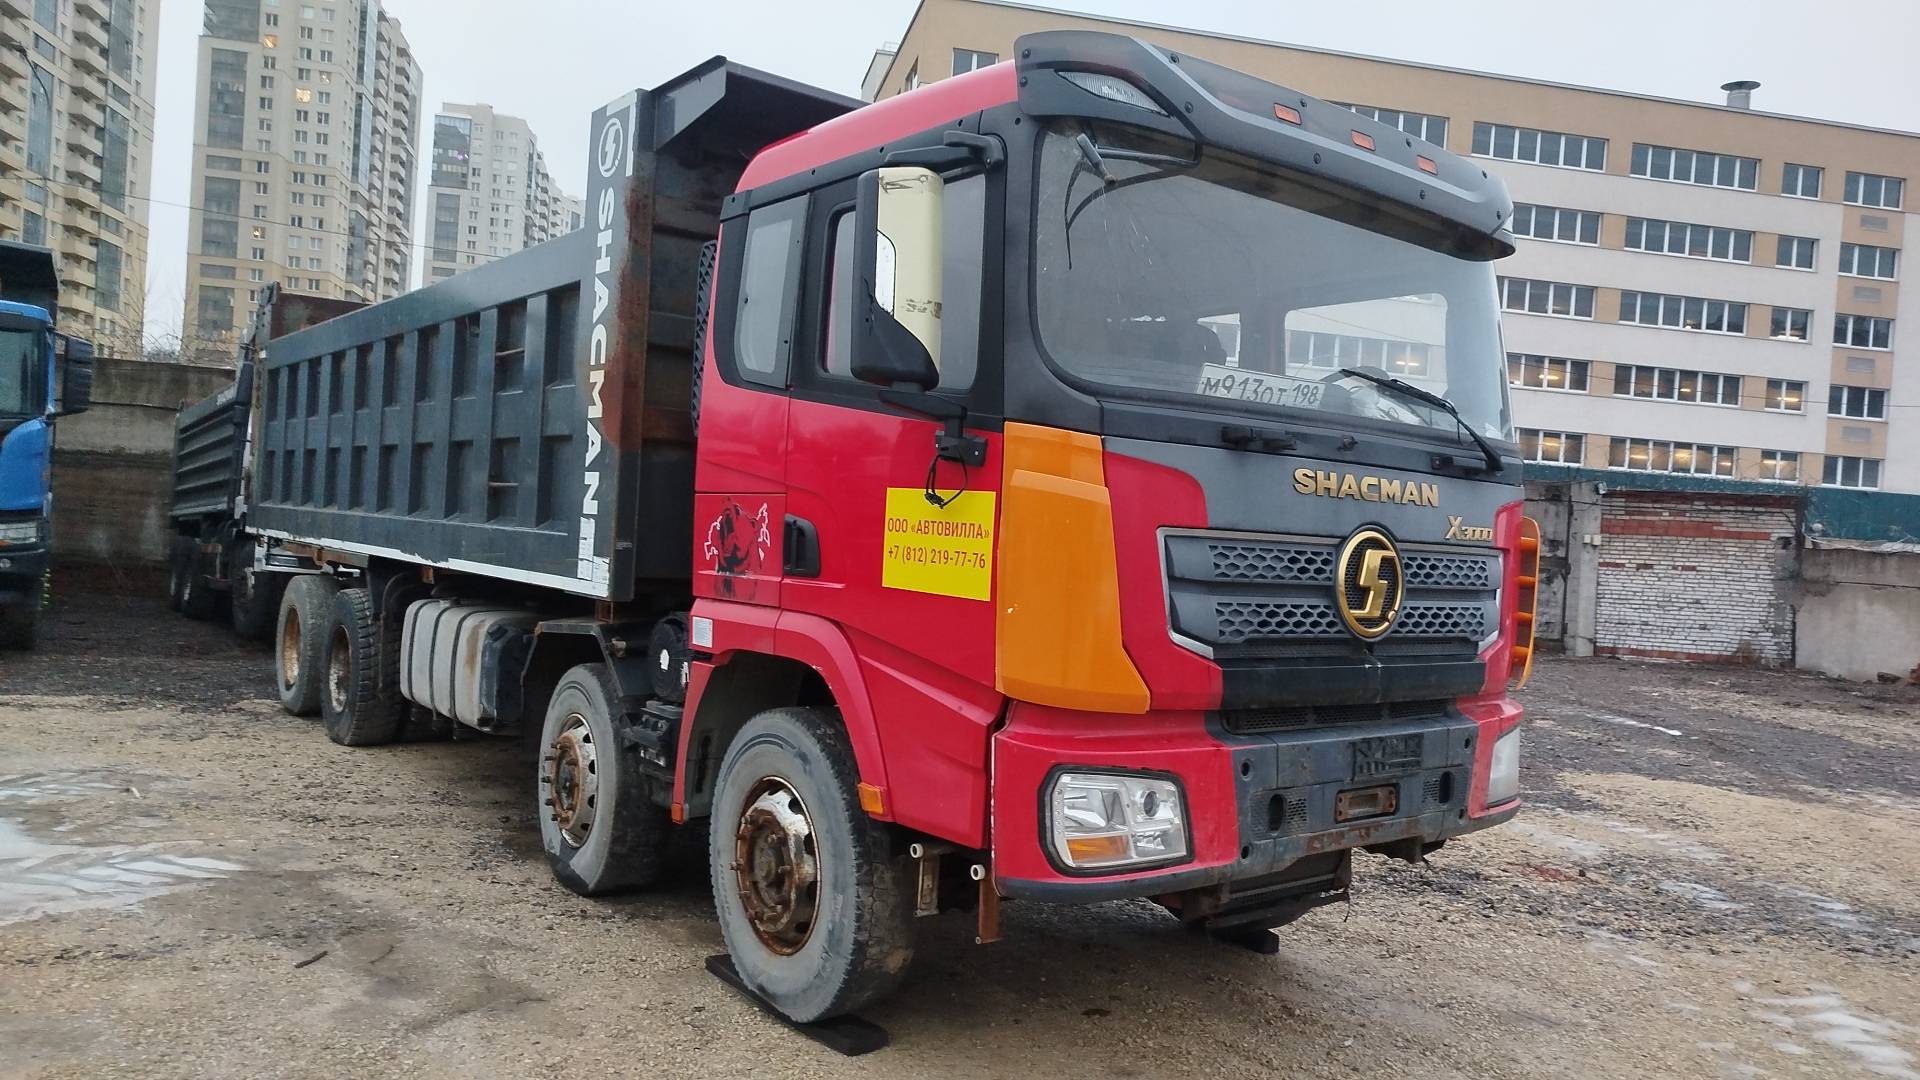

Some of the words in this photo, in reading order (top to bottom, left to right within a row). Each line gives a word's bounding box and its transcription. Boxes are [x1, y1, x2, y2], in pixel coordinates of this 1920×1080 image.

[583, 187, 614, 515] SHACMAN
[1292, 384, 1319, 404] 198
[1293, 468, 1440, 507] SHACMAN
[887, 518, 909, 533] ООО
[911, 520, 990, 539] «АВТОВИЛЛА»
[888, 545, 899, 560] +7
[902, 546, 928, 565] (812)
[930, 549, 986, 569] 219-77-76
